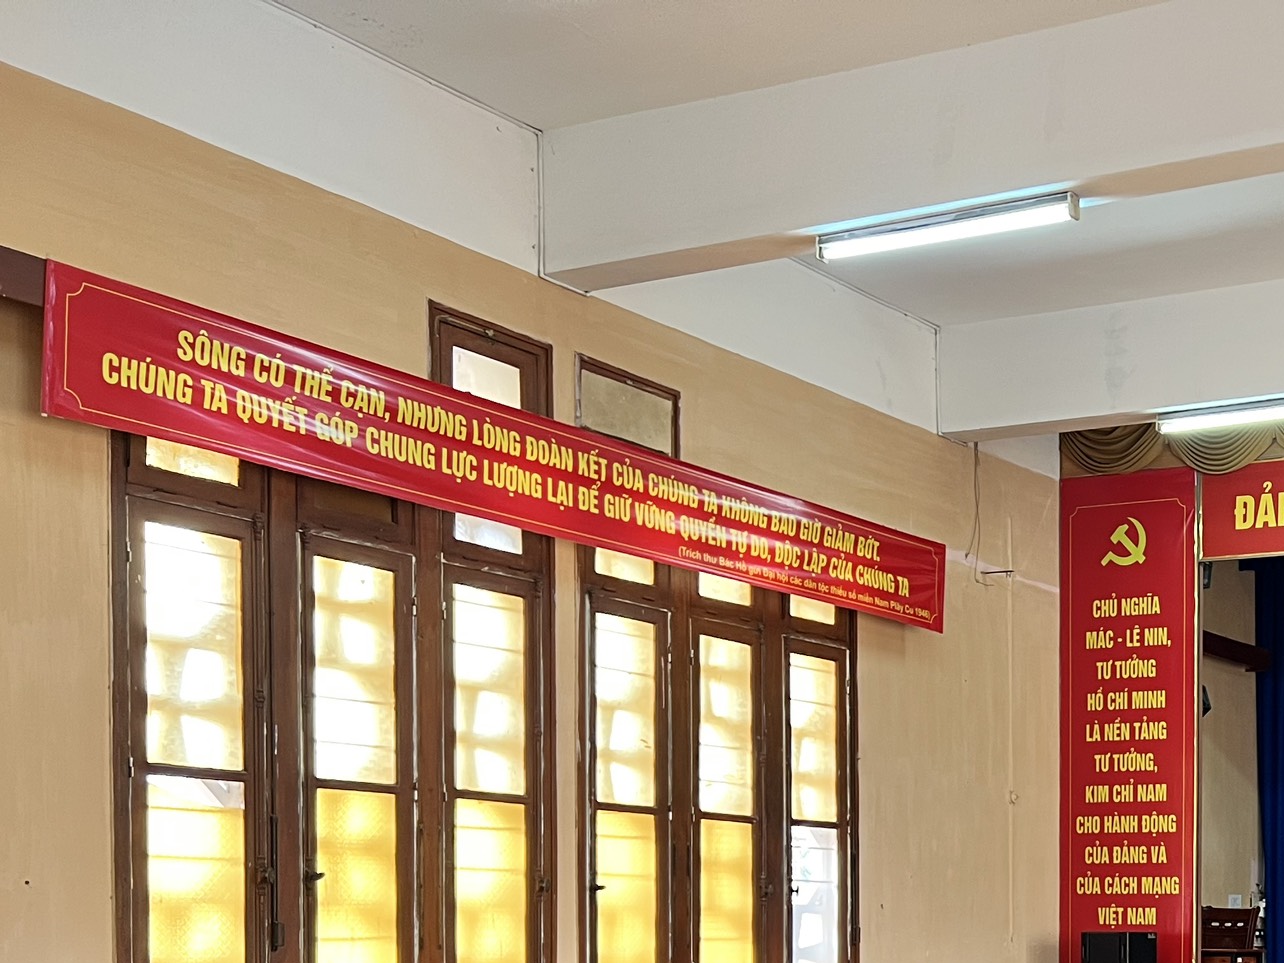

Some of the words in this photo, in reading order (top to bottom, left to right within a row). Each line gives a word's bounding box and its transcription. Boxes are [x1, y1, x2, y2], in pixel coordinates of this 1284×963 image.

[177, 329, 246, 377] SÔNG
[253, 353, 286, 388] CÓ
[292, 362, 334, 402] THỂ
[341, 380, 390, 423] CẠN,
[397, 396, 468, 441] NHƯNG
[472, 417, 521, 457] LÒNG
[526, 436, 573, 472] ĐOÀN
[578, 449, 607, 481] KẾT
[612, 458, 644, 493] CỦA
[648, 474, 699, 508] CHÚNG
[702, 489, 718, 515] TA
[722, 496, 768, 529] KHÔNG
[771, 510, 796, 536] BAO
[800, 518, 822, 544] GIỜ
[823, 523, 855, 555] GIẢM
[858, 535, 881, 561] BỚT.
[102, 352, 193, 405] CHÚNG
[201, 378, 228, 414] TA
[236, 390, 308, 435] QUYẾT
[315, 406, 358, 448] GÓP
[366, 426, 435, 471] CHUNG
[441, 447, 478, 483] LỰC
[483, 459, 542, 499] LƯỢNG
[547, 477, 573, 511] LẠI
[578, 481, 601, 514] ĐỂ
[604, 493, 632, 522] GIỮ
[635, 501, 676, 535] VỮNG
[680, 515, 727, 548] QUYỀN
[730, 529, 748, 558] TỰ
[751, 536, 771, 564] DO,
[775, 540, 801, 571] ĐỘC
[803, 547, 827, 577] LẬP
[829, 553, 854, 582] CỦA
[856, 565, 895, 593] CHÚNG
[897, 576, 910, 598] TA
[1093, 593, 1117, 618] CHỦ
[1121, 593, 1161, 616] NGHĨA
[1086, 627, 1114, 649] MÁC
[1126, 625, 1141, 647] LÊ
[1144, 627, 1171, 648] NIN,
[1096, 659, 1113, 680] TƯ
[1115, 654, 1157, 679] TƯỞNG
[1087, 687, 1104, 711] HỒ
[1107, 688, 1128, 710] CHÍ
[1132, 690, 1166, 709] MINH
[1086, 720, 1101, 742] LÀ
[1104, 717, 1130, 741] NỀN
[1133, 716, 1167, 740] TẢNG
[1094, 753, 1111, 772] TƯ
[1113, 748, 1158, 773] TƯỞNG,
[1085, 785, 1109, 803] KIM
[1113, 779, 1134, 802] CHỈ
[1137, 784, 1167, 802] NAM
[1076, 816, 1100, 834] CHO
[1104, 812, 1138, 833] HÀNH
[1142, 811, 1177, 837] ĐỘNG
[1085, 841, 1109, 864] CỦA
[1113, 840, 1147, 864] ĐẢNG
[1151, 842, 1167, 864] VÀ
[1076, 871, 1101, 895] CỦA
[1104, 873, 1137, 894] CÁCH
[1141, 877, 1180, 899] MẠNG
[1098, 904, 1124, 929] VIỆT
[1127, 907, 1157, 925] NAM
